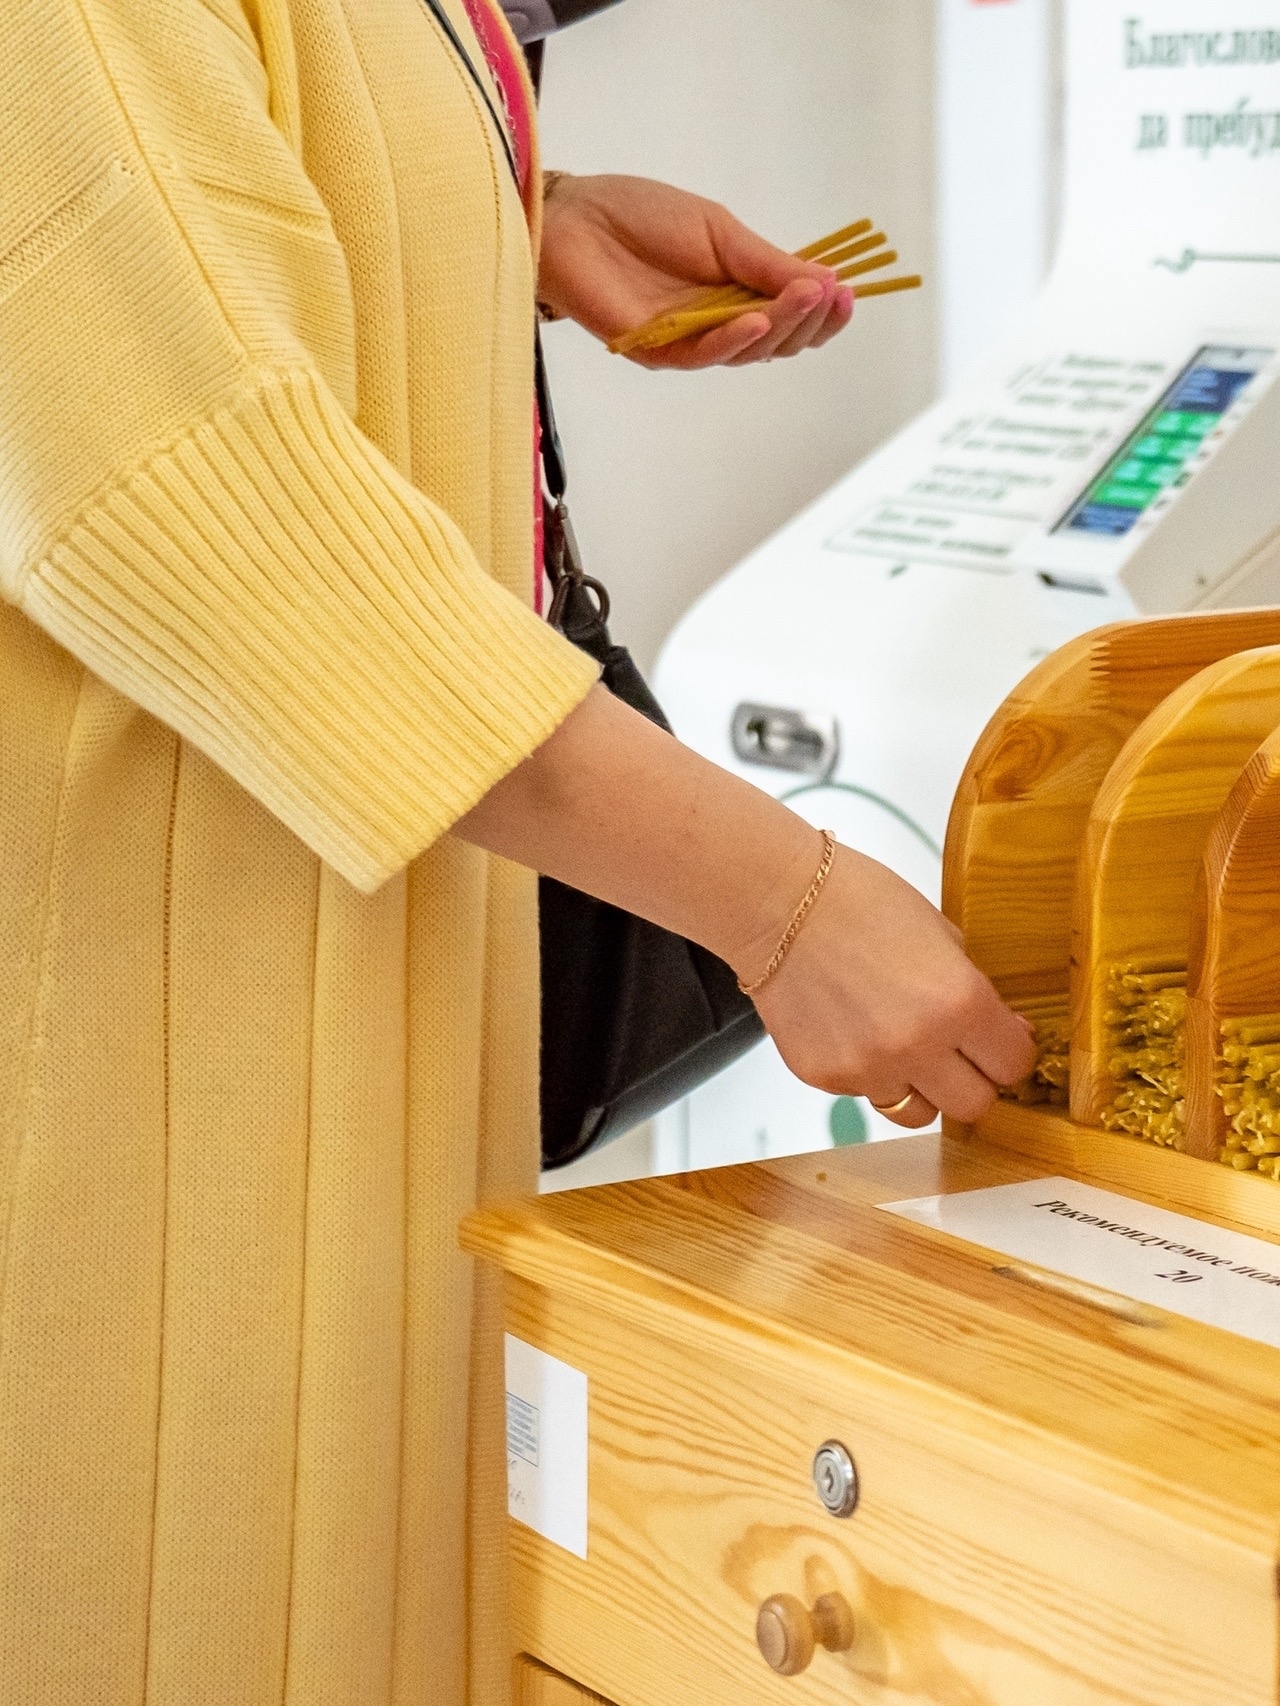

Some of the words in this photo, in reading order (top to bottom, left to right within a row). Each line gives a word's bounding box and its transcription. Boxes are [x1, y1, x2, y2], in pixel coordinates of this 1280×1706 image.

[1136, 112, 1168, 150] да
[1032, 1199, 1233, 1267] Рекомендуемое
[1153, 1268, 1204, 1284] 20
